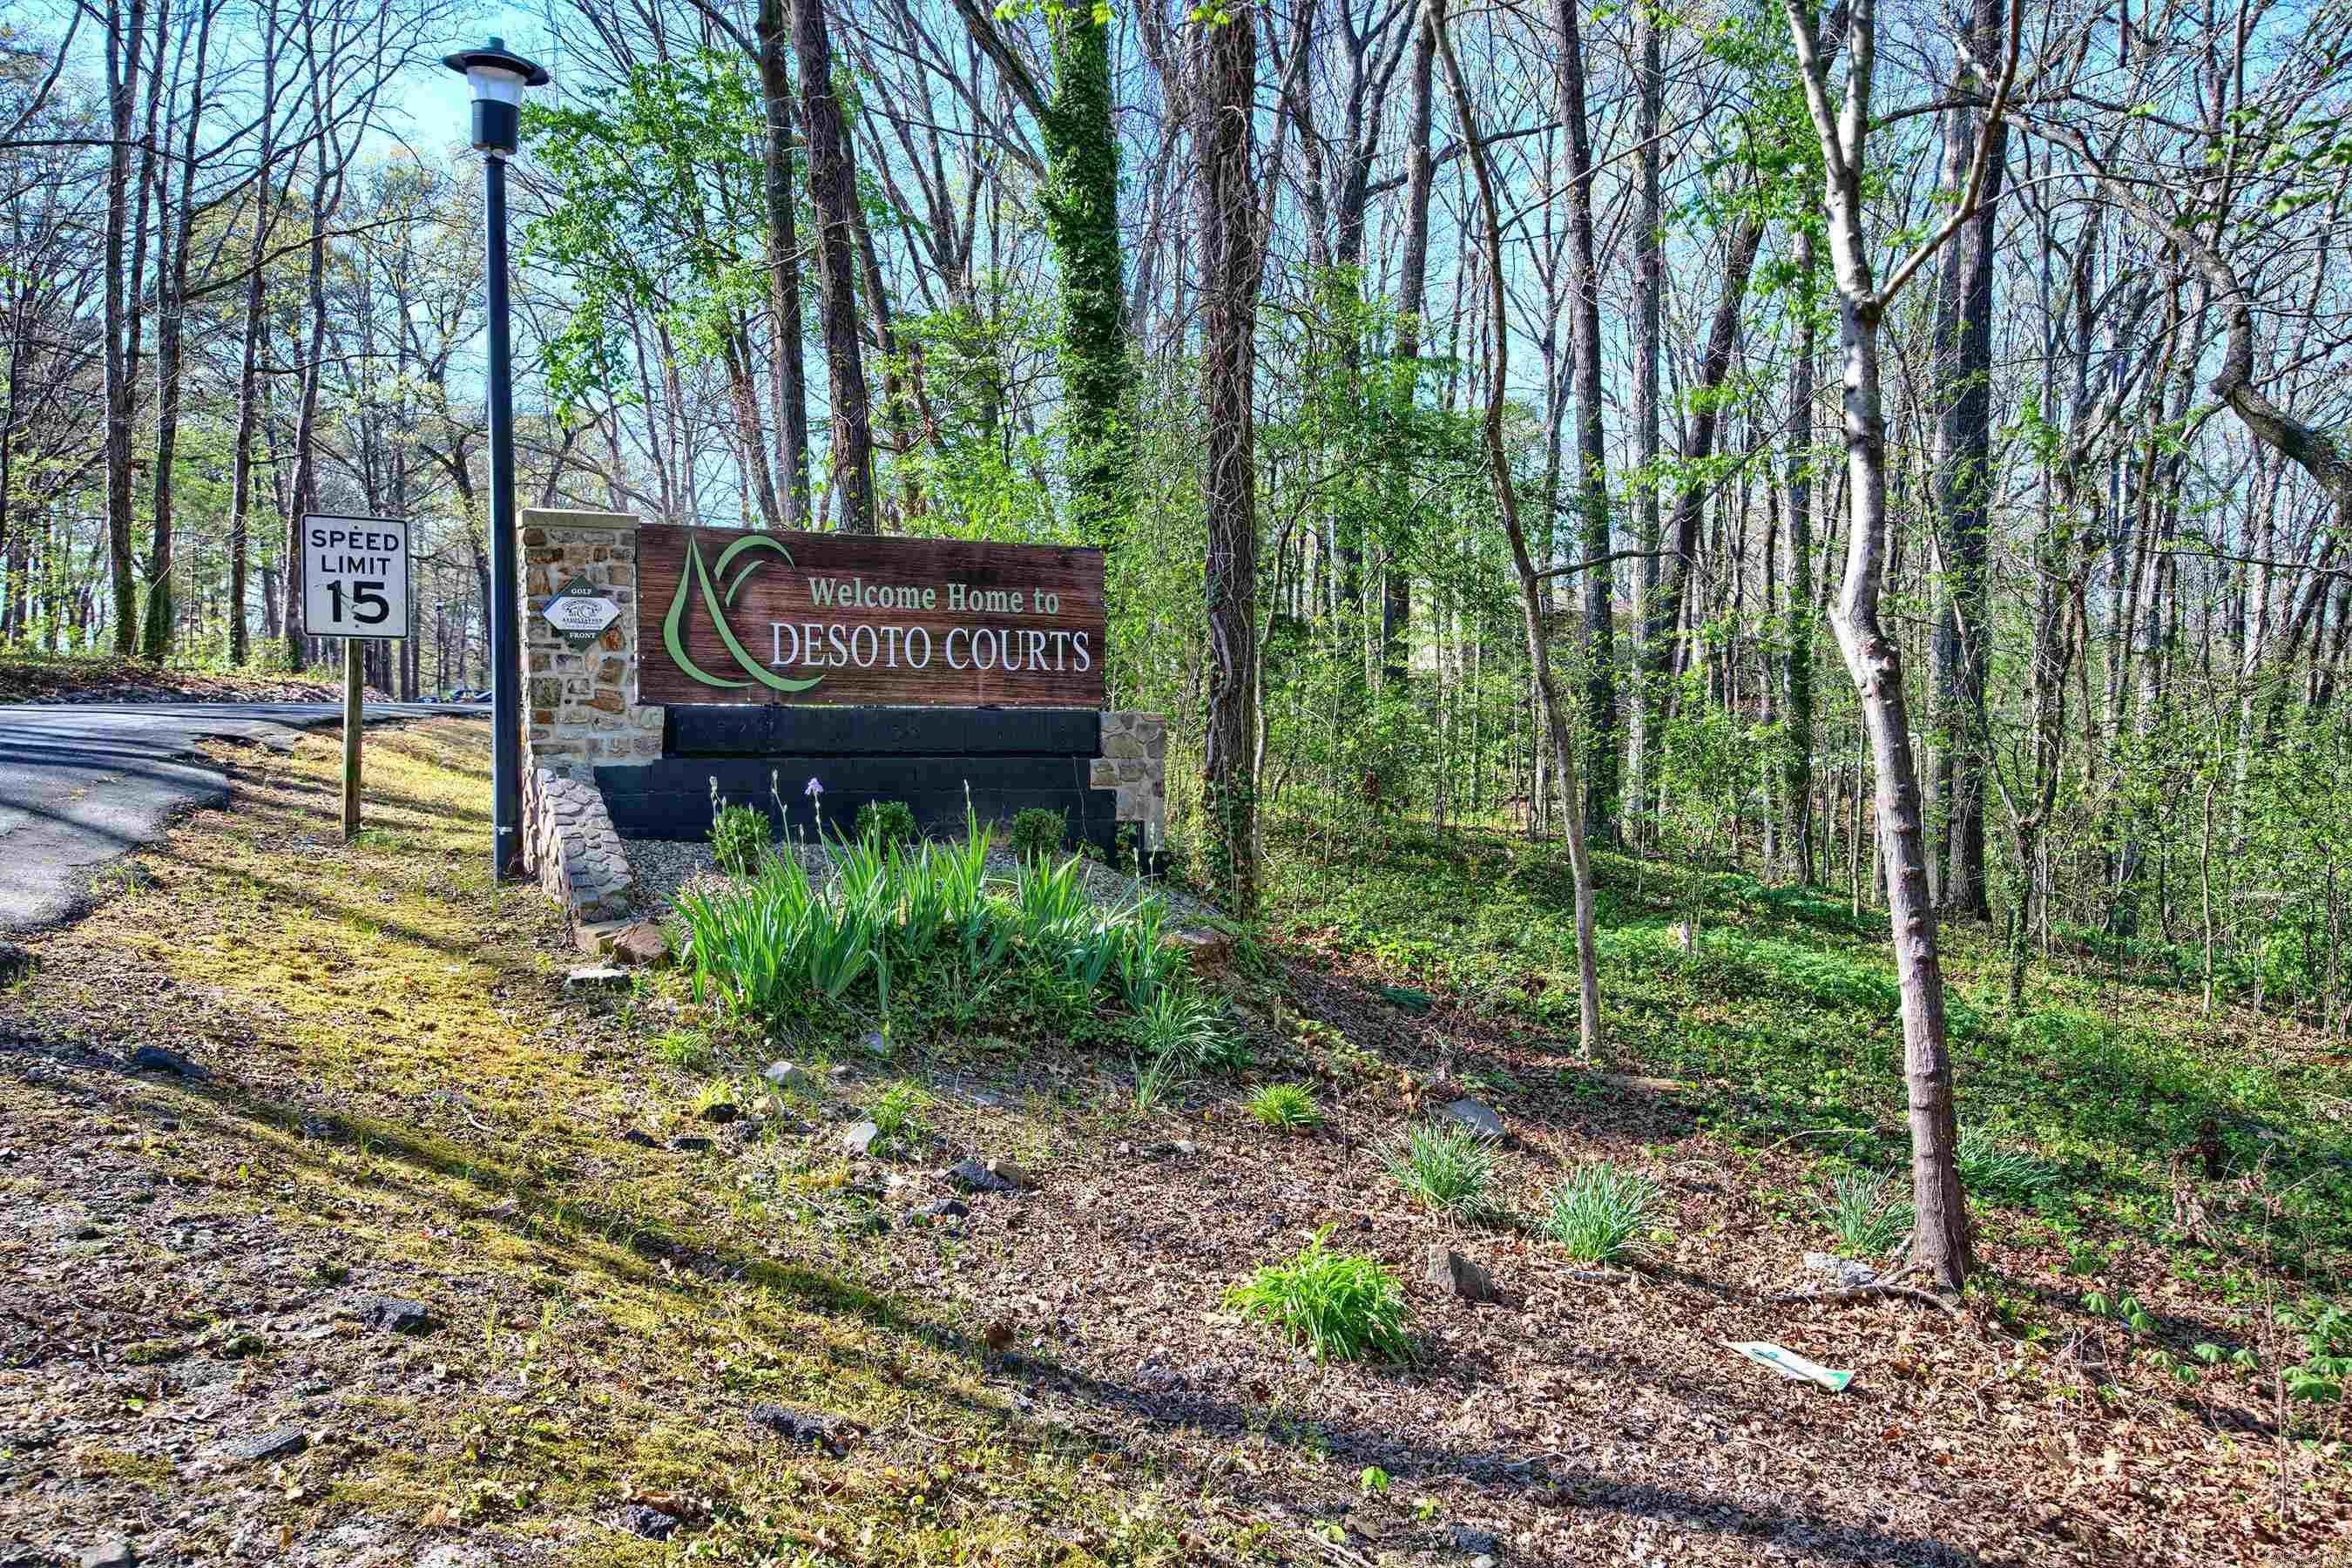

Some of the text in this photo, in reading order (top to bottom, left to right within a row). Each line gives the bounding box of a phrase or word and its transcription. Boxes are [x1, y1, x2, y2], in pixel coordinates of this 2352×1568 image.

[311, 529, 399, 551] SPEED
[321, 555, 390, 575] LIMIT
[327, 579, 389, 624] 15
[808, 577, 1059, 614] Welcome Home to
[770, 622, 1090, 672] DESOTO COURTS
